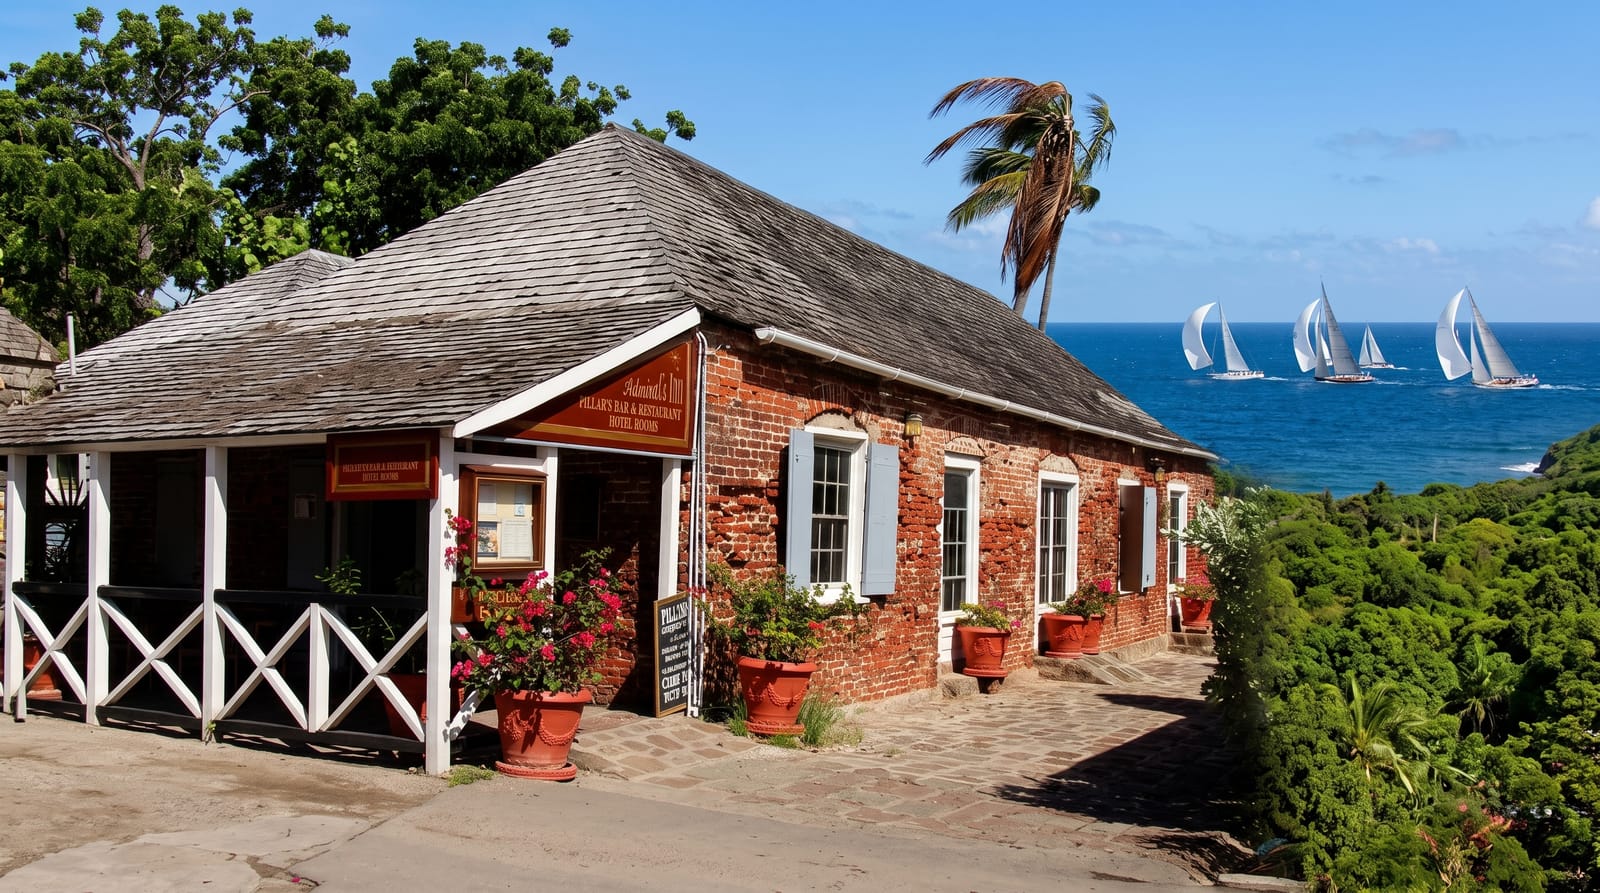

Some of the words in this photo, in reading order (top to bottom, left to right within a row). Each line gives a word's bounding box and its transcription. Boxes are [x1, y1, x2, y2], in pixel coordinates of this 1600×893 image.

[623, 373, 667, 402] Admiral's
[669, 372, 683, 405] Inn
[579, 396, 613, 412] PILLAR'S
[614, 401, 629, 414] BAR
[630, 402, 637, 415] &
[638, 403, 682, 421] RESTAURANT
[609, 415, 632, 429] HOTEL
[634, 418, 658, 432] ROOMS
